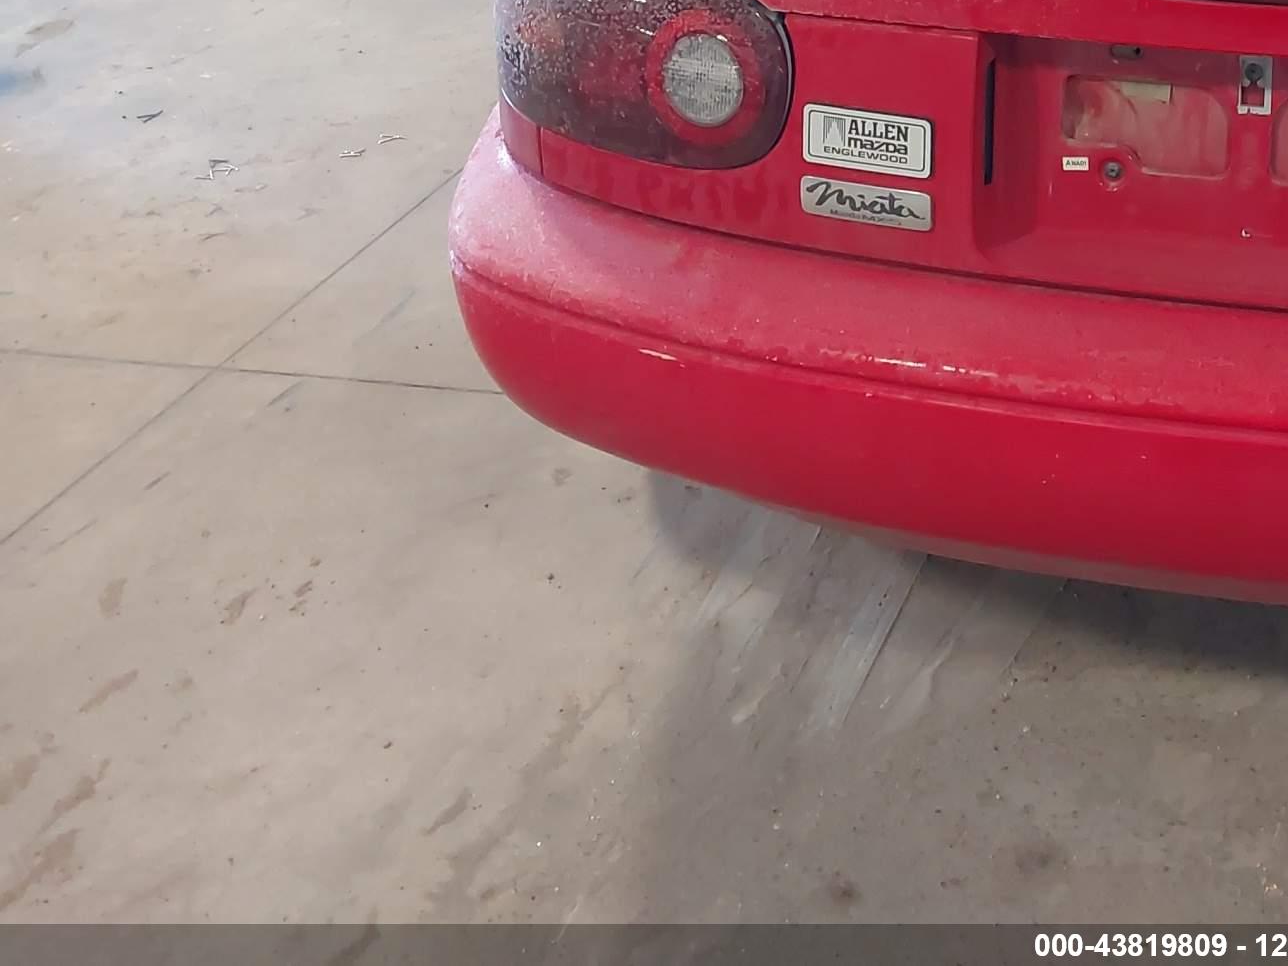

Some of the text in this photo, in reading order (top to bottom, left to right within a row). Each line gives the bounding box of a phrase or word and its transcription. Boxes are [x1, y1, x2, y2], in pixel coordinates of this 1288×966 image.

[848, 119, 909, 143] ALLEN
[824, 146, 908, 164] ENGLEWOOD
[806, 181, 926, 220] Miata
